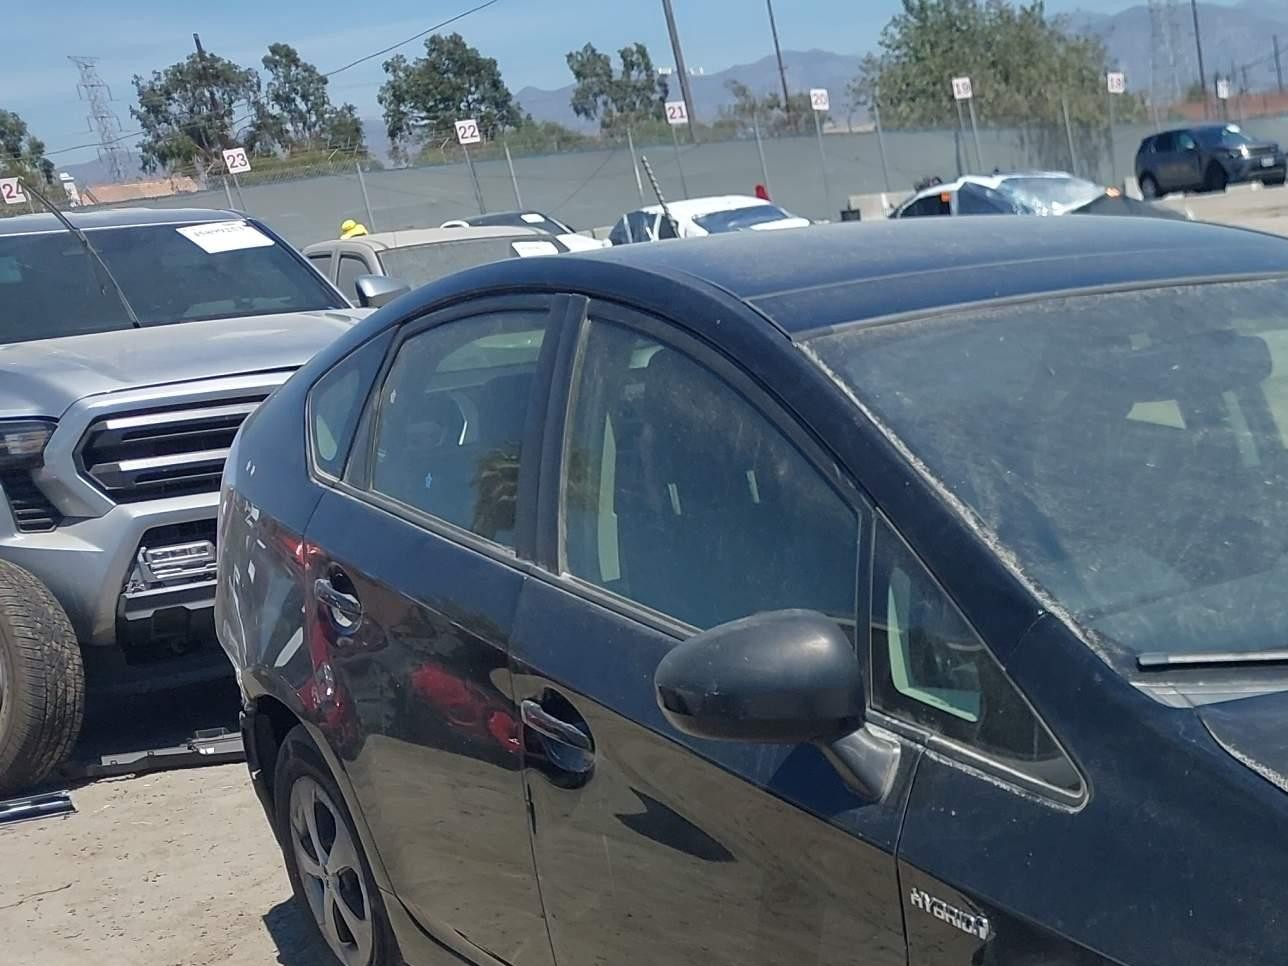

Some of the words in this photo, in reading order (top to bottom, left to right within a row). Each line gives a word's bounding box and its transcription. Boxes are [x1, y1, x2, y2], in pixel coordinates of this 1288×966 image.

[955, 81, 970, 96] 19
[668, 105, 685, 119] 21
[459, 124, 479, 139] 22
[227, 153, 247, 168] 23
[2, 179, 25, 199] 24
